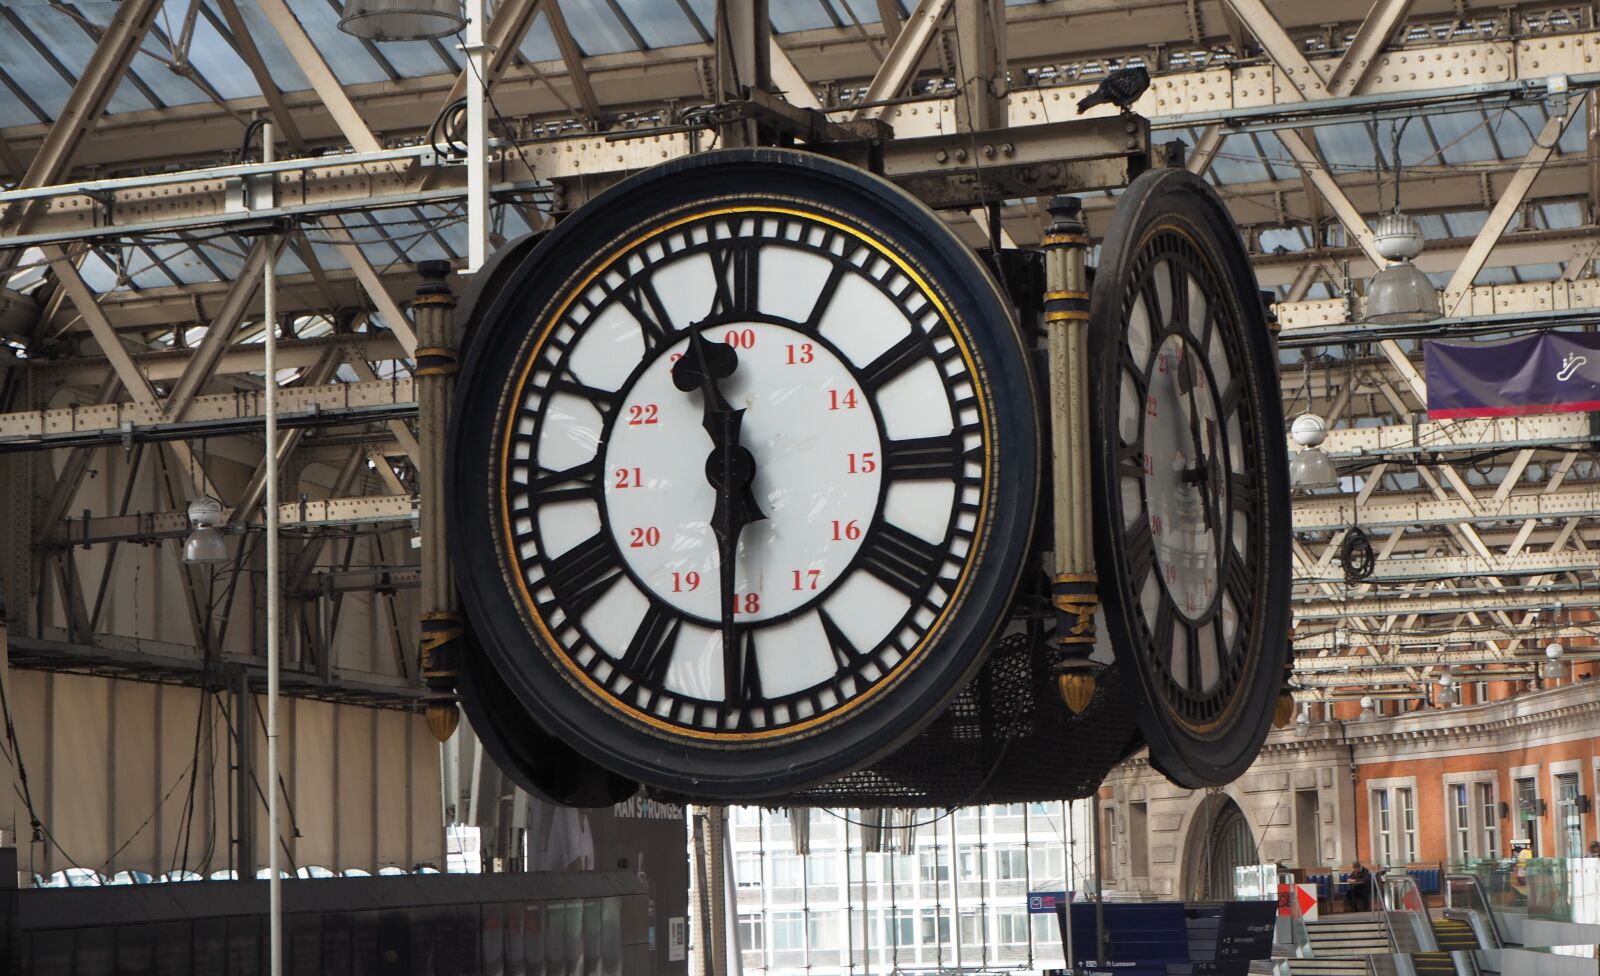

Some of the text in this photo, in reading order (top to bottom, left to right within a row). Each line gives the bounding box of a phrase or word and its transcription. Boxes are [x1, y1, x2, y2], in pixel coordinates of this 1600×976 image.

[708, 240, 761, 317] XII
[616, 270, 677, 348] XI
[725, 329, 756, 349] 00
[785, 343, 814, 365] 13
[862, 324, 938, 392] II
[828, 388, 857, 411] 14
[1146, 395, 1158, 417] 22
[628, 404, 658, 426] 22
[847, 452, 876, 474] 15
[885, 434, 956, 480] III
[1143, 455, 1154, 476] 21
[536, 457, 600, 502] IX
[615, 467, 642, 489] 21
[630, 526, 660, 548] 20
[831, 519, 861, 541] 16
[1151, 515, 1162, 537] 20
[549, 536, 627, 617] VIII
[671, 571, 700, 593] 19
[791, 569, 821, 591] 17
[1165, 563, 1176, 585] 19
[732, 592, 760, 614] 18
[623, 608, 682, 688] VII
